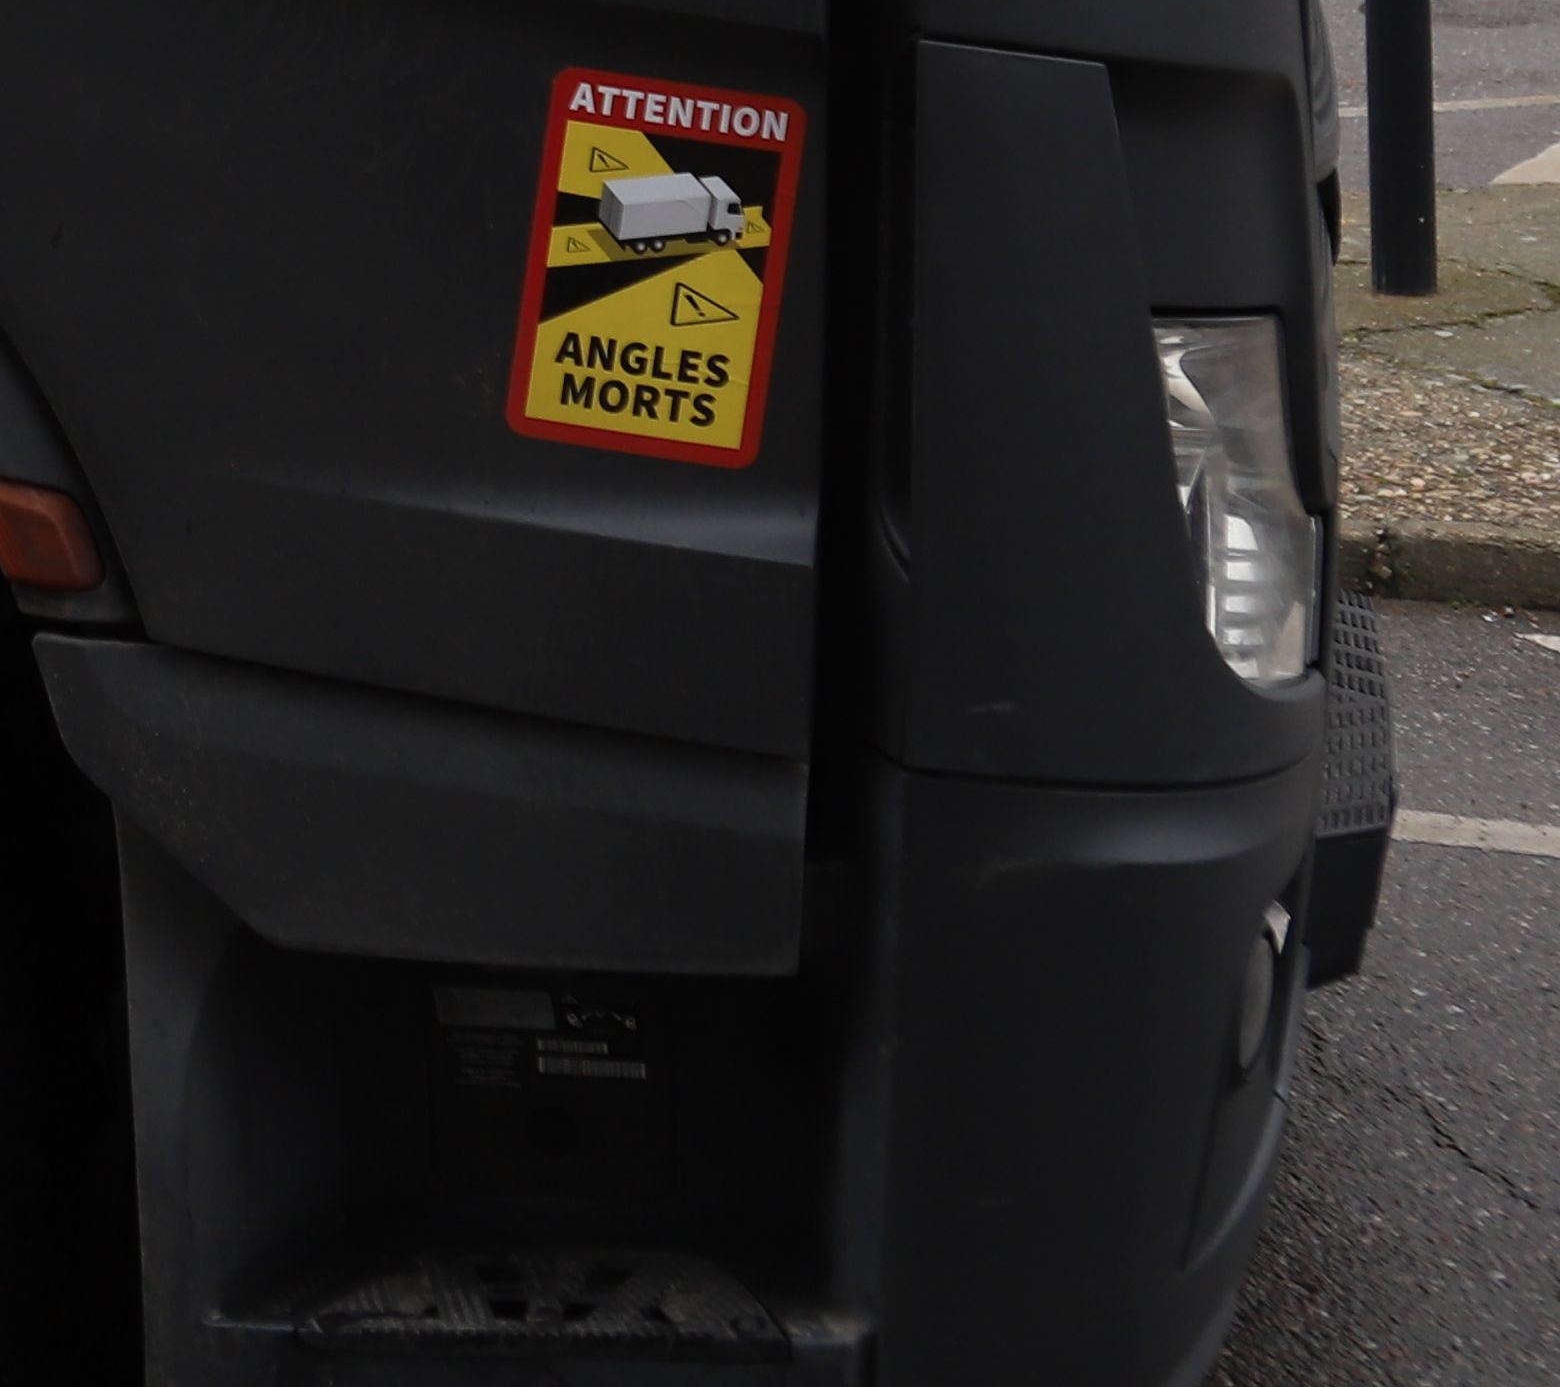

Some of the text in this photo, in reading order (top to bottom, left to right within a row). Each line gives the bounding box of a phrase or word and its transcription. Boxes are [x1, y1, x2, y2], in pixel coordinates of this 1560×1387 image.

[568, 81, 790, 143] ATTENTION
[554, 331, 731, 389] ANGLES
[559, 372, 718, 428] MORTS
